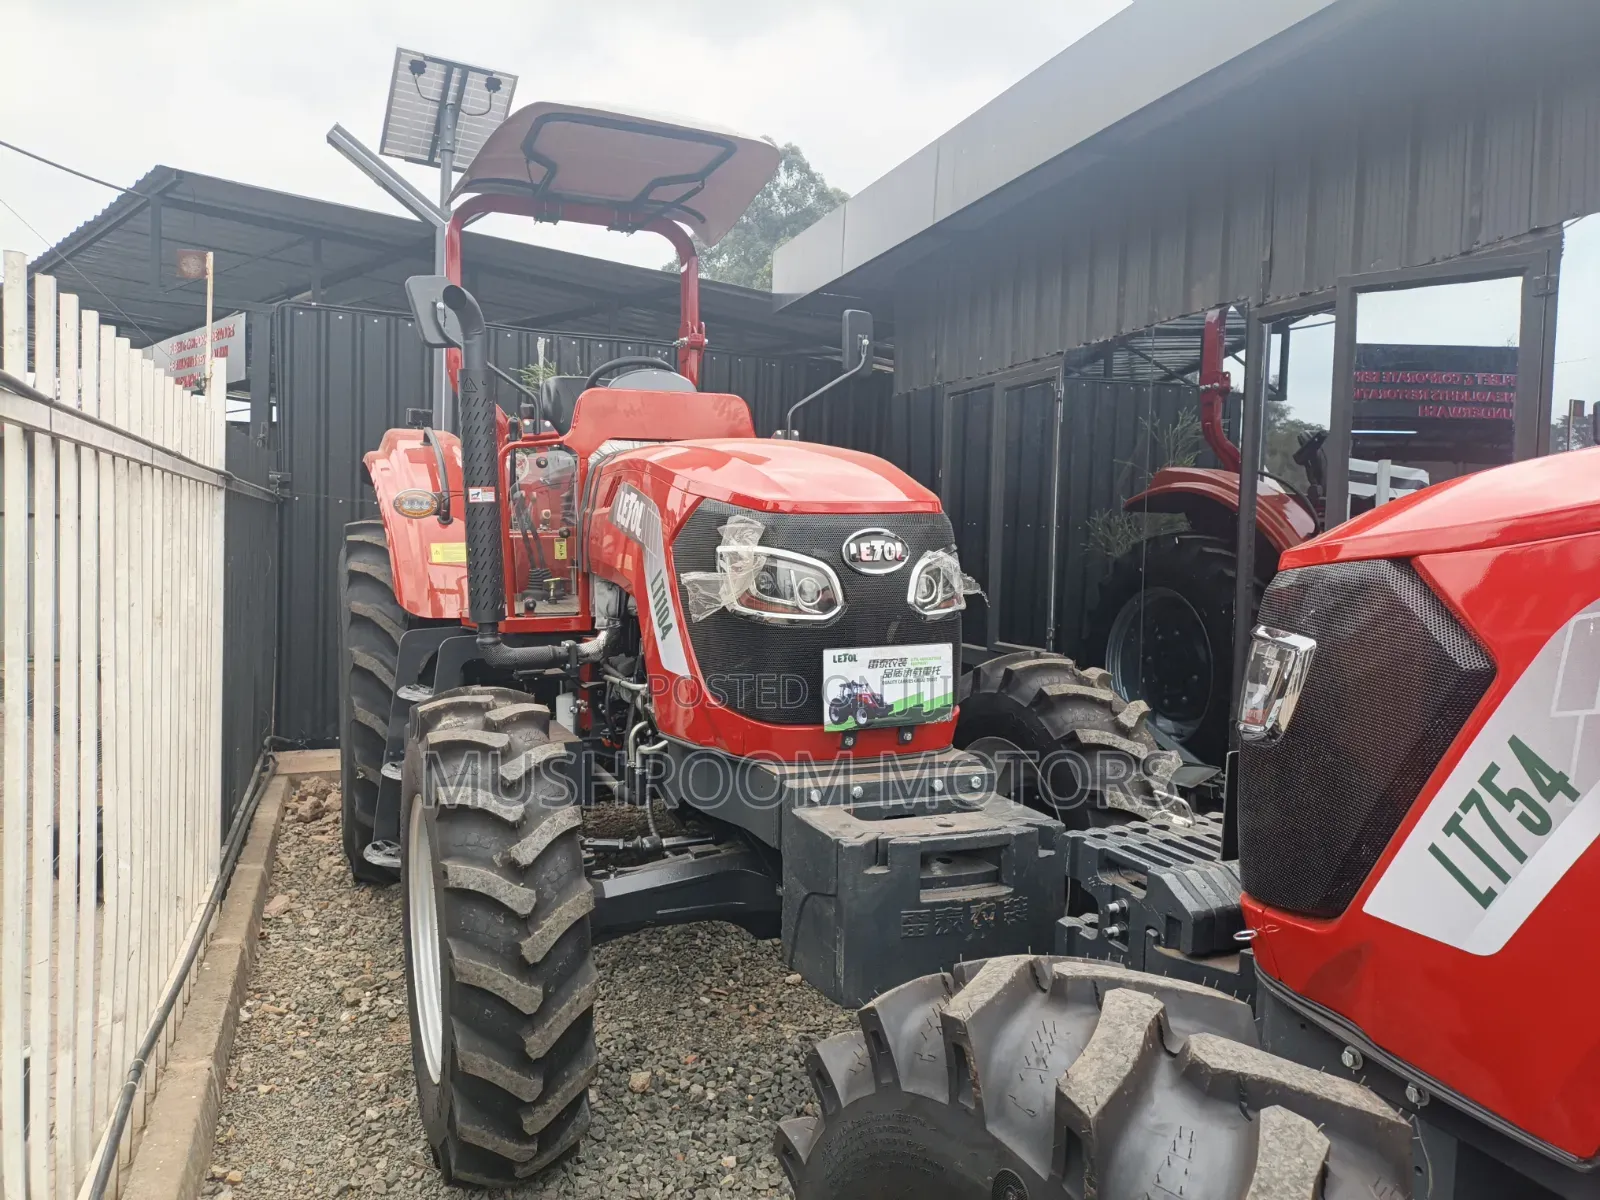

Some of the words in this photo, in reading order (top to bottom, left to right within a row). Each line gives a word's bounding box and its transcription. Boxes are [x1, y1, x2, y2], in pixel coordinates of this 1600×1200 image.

[616, 491, 646, 537] LETOL
[849, 540, 906, 562] LETOL
[650, 569, 673, 642] LT1104
[833, 653, 858, 663] LETOL
[1427, 734, 1581, 911] LT754
